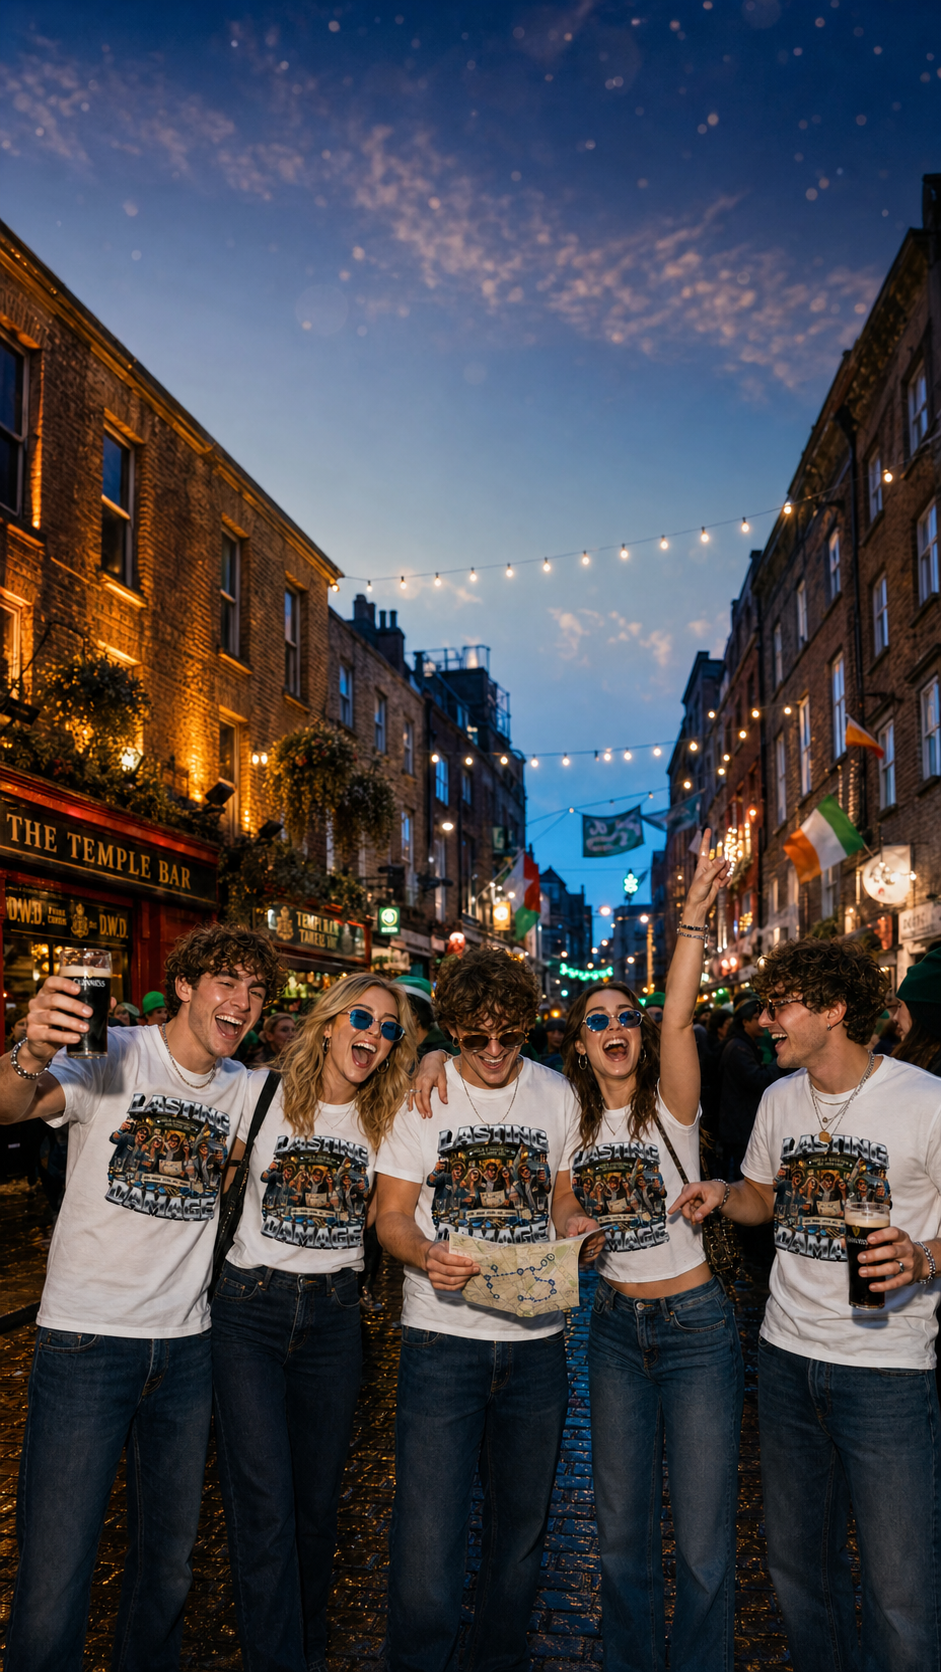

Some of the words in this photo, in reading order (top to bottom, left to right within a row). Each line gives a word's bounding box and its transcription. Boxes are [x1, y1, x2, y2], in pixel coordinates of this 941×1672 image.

[6, 813, 57, 852] THE
[67, 831, 151, 879] TEMPLE
[158, 860, 191, 890] BAR
[127, 1093, 231, 1136] LASTING
[272, 1135, 369, 1166] LASTING
[438, 1124, 549, 1154] LASTING
[780, 1133, 890, 1169] LASTING
[104, 1180, 215, 1221] DAMAGE
[260, 1215, 363, 1250] DAMAGE
[434, 1220, 550, 1244] DMAGE
[774, 1226, 848, 1262] DAMA
